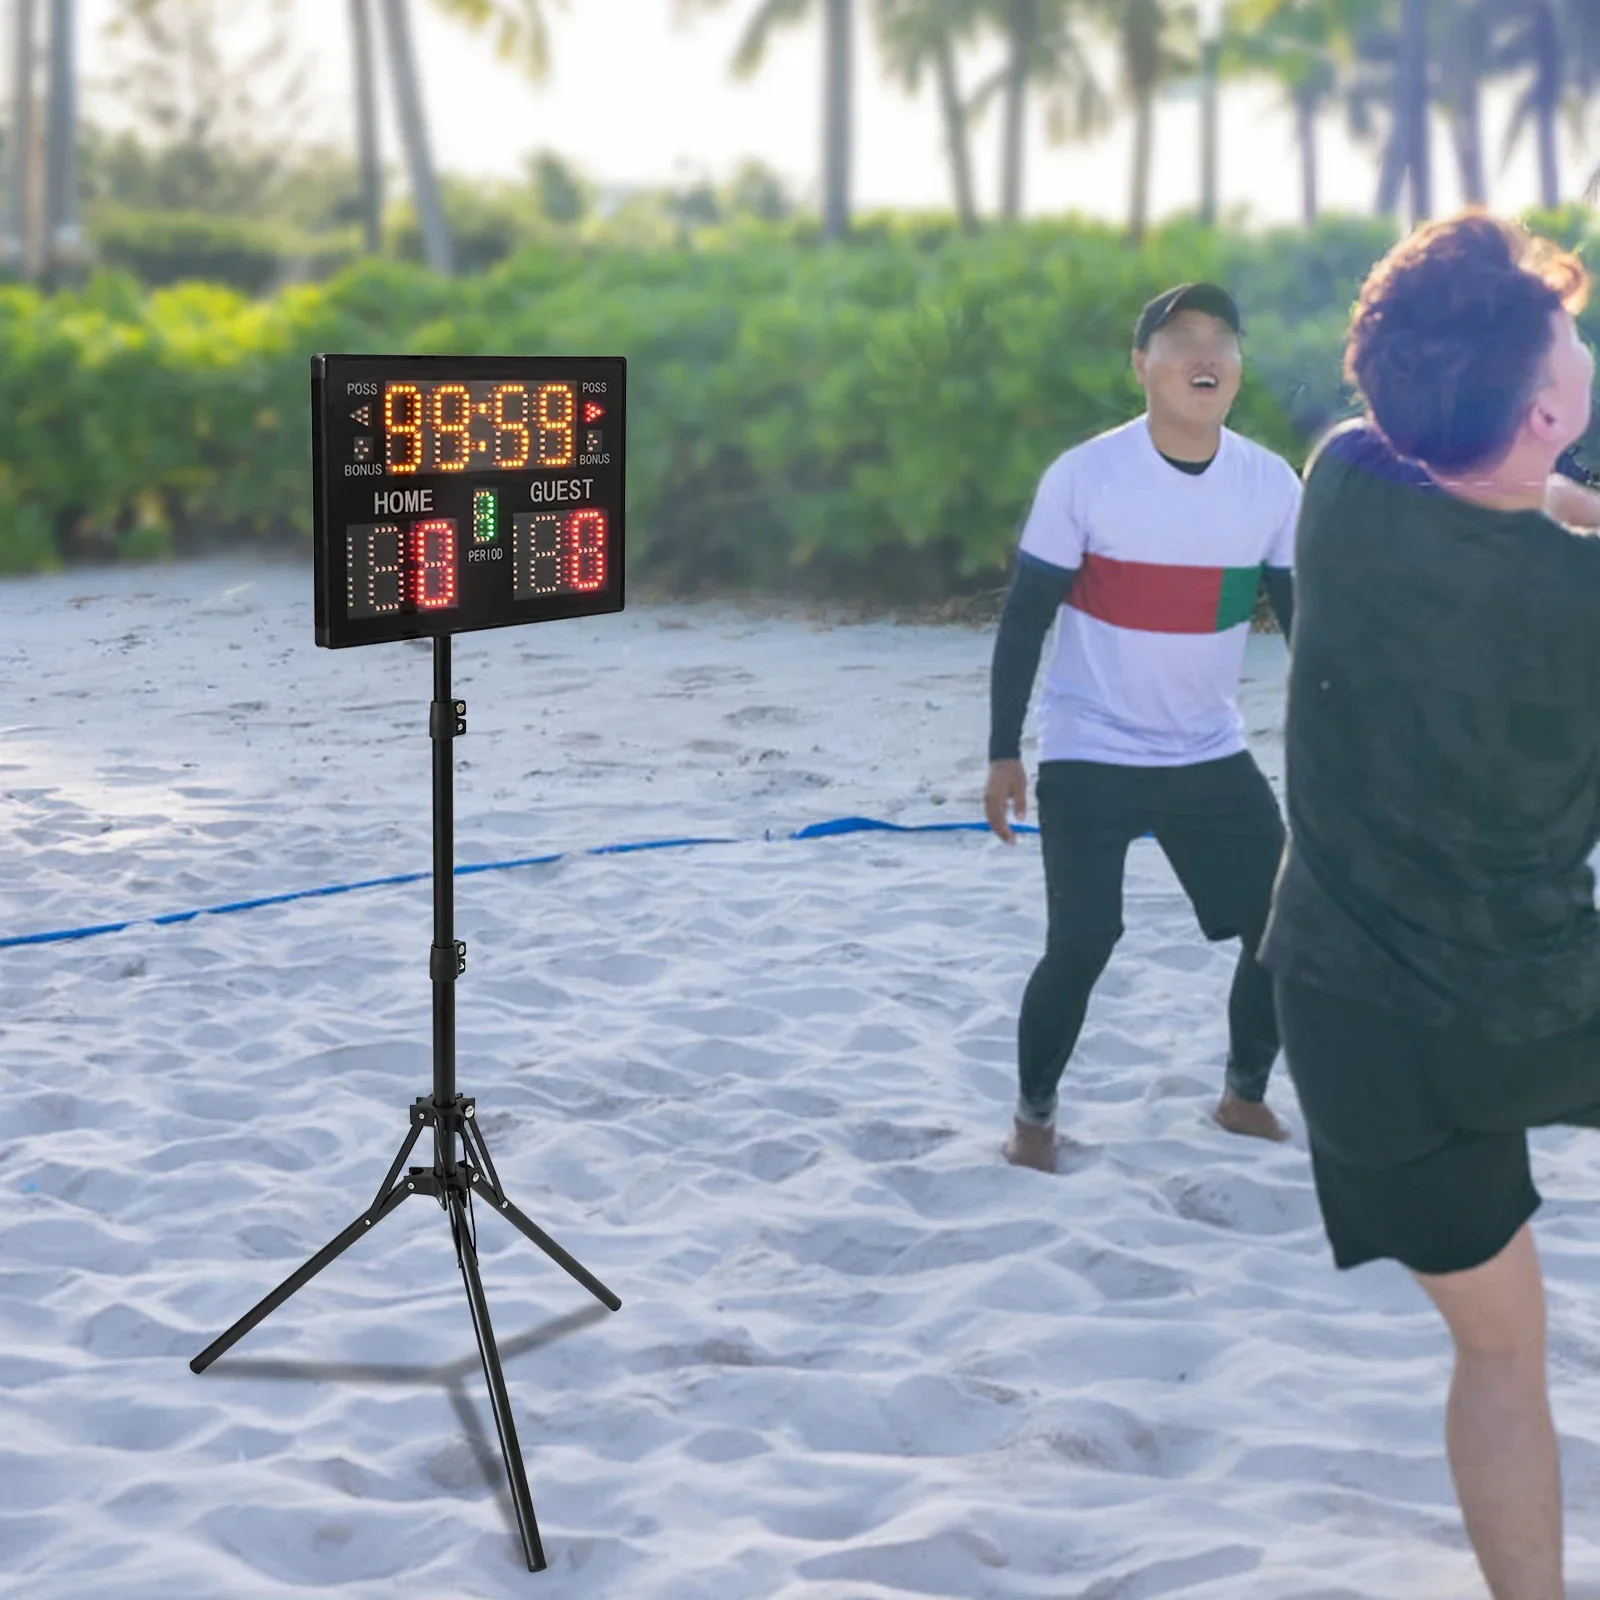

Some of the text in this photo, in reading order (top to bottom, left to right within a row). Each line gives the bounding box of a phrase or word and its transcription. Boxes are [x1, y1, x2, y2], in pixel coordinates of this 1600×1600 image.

[347, 382, 378, 396] POSS
[582, 382, 607, 393] POSS
[579, 453, 610, 465] BONUS
[344, 463, 383, 477] BONUS
[530, 478, 594, 502] GUEST
[374, 489, 434, 515] HOME
[468, 547, 503, 562] PERIOD
